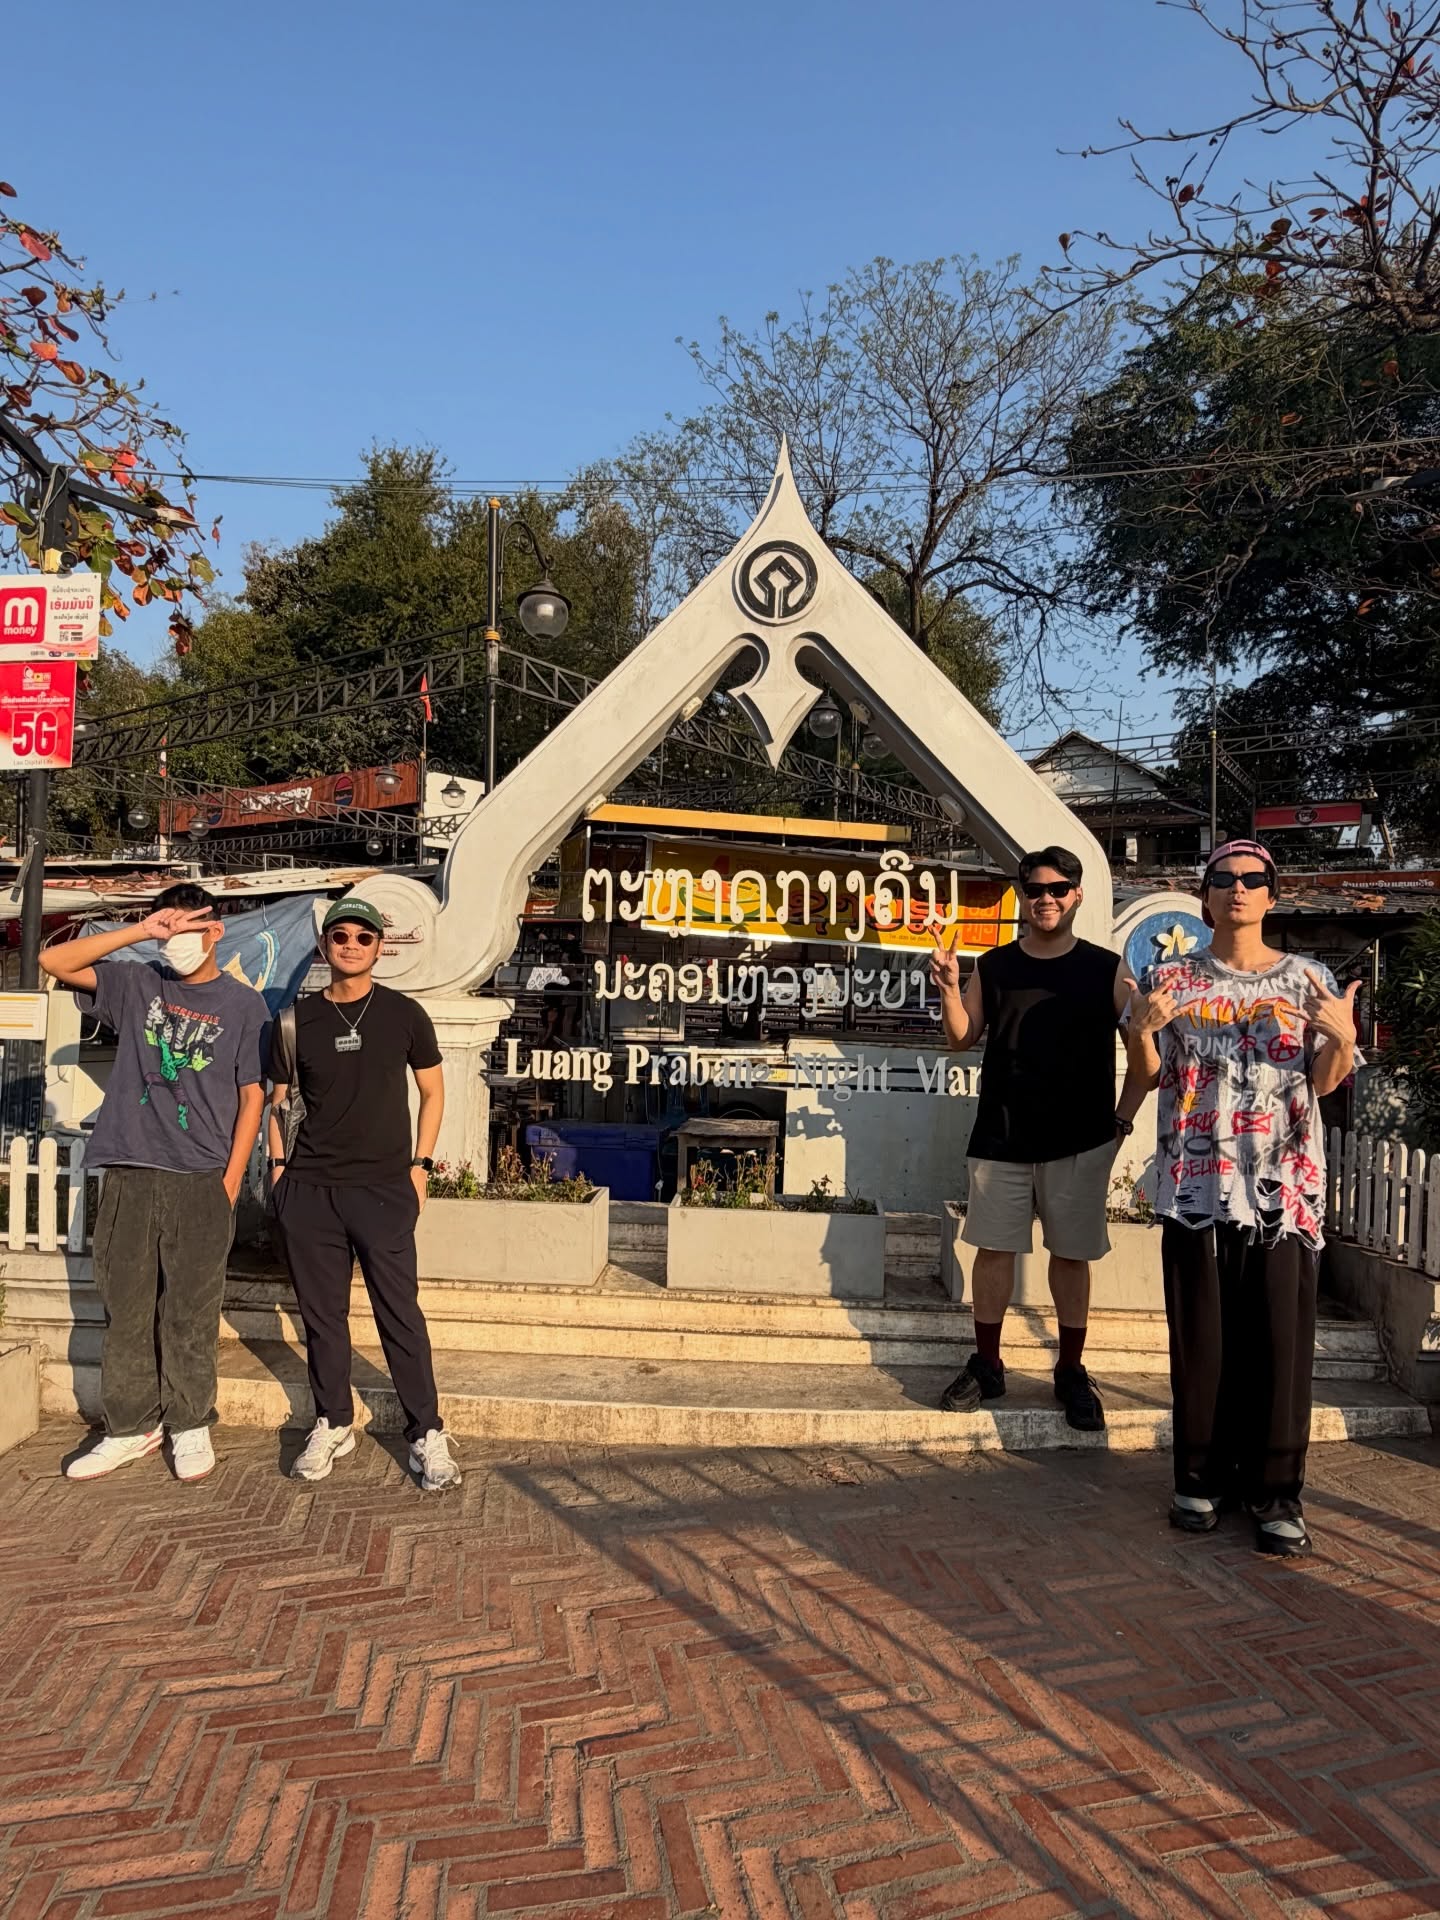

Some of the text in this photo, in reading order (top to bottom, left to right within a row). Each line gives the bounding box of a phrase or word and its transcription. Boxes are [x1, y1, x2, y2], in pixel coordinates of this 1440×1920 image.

[3, 626, 37, 637] money
[12, 711, 57, 757] 5G
[1184, 1035, 1241, 1065] PUNK
[504, 1038, 613, 1092] Luang
[793, 1053, 893, 1101] Night
[917, 1055, 983, 1098] Mar
[1226, 1088, 1283, 1115] DEAD
